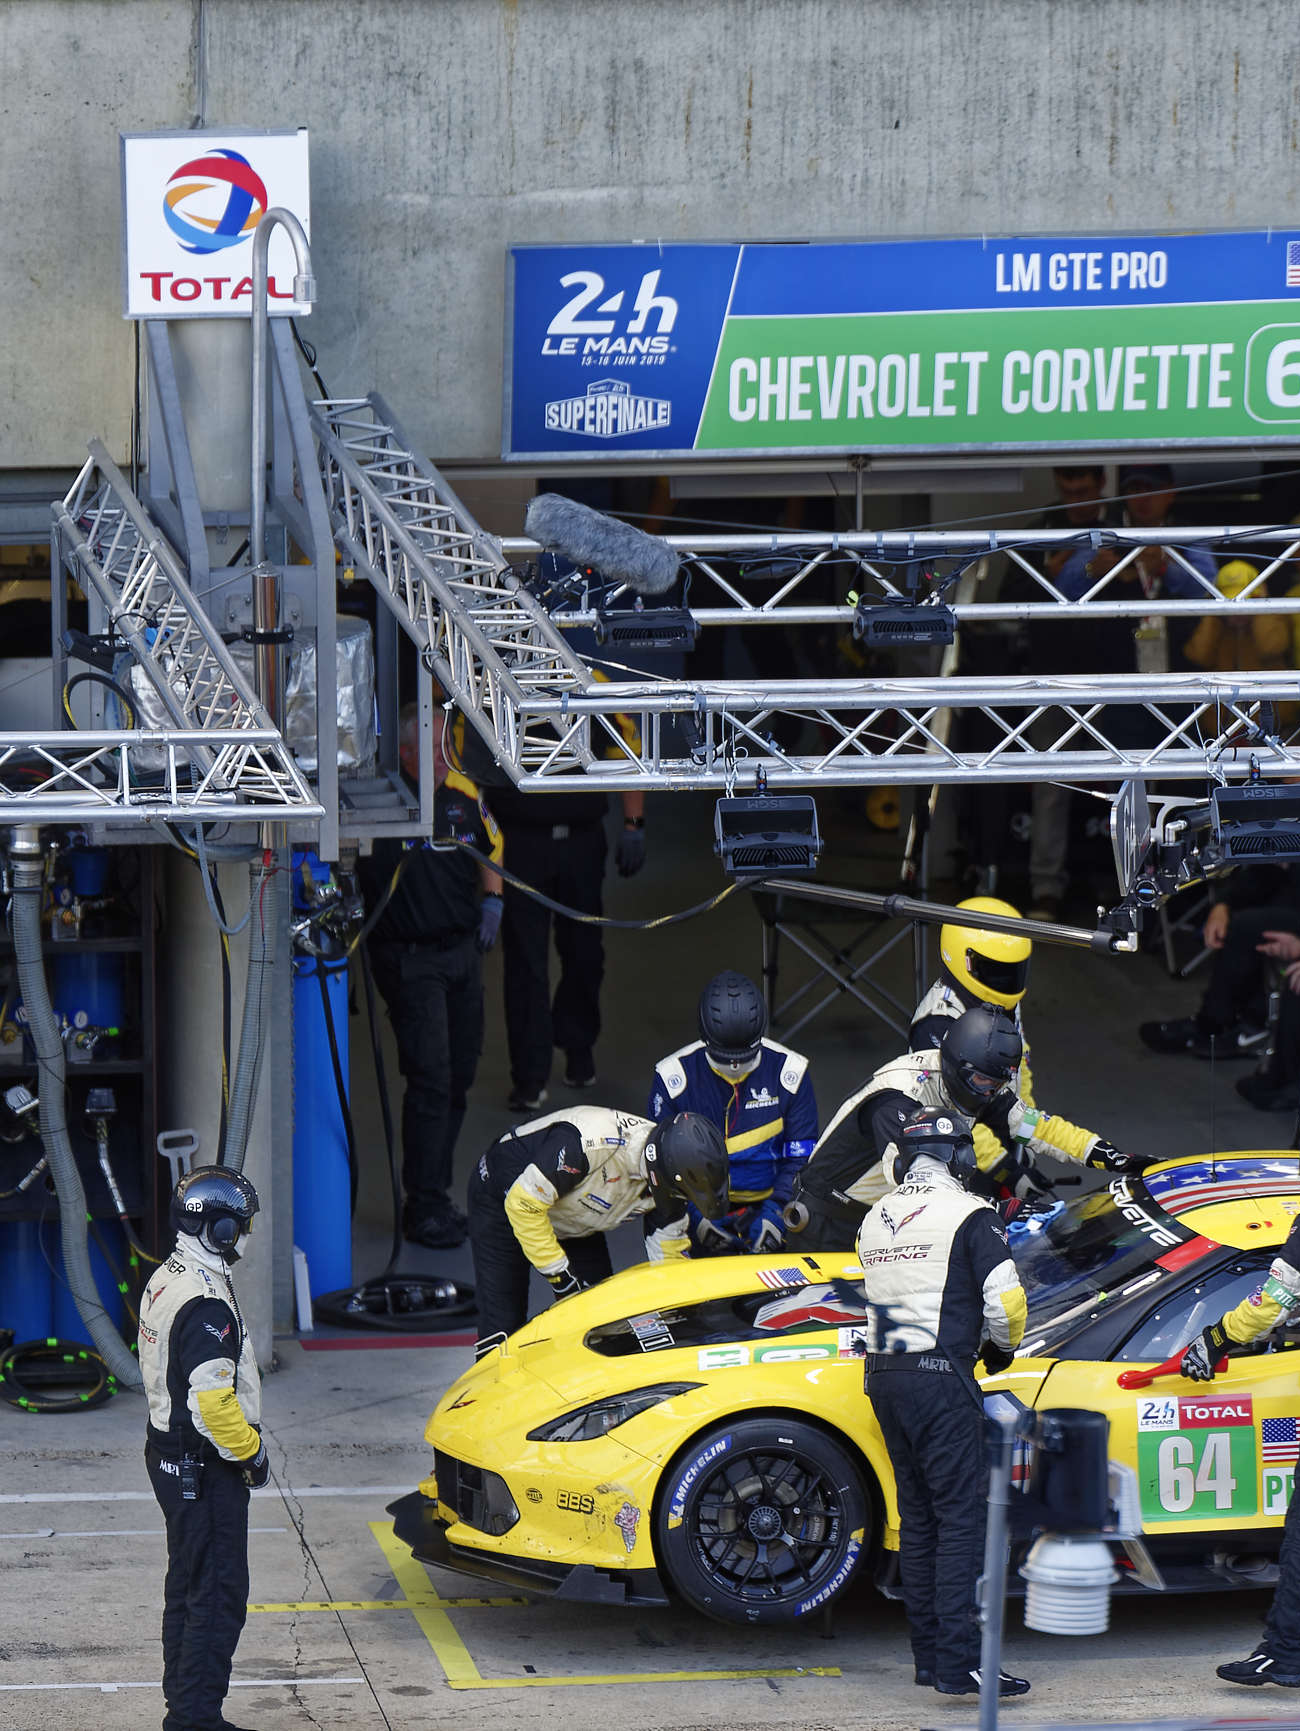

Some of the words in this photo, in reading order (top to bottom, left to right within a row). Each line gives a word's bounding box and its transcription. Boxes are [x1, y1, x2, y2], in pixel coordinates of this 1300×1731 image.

[139, 271, 295, 302] TOTAL
[996, 253, 1042, 292] LM
[1049, 252, 1103, 291] GTE
[1110, 251, 1168, 289] PRO
[546, 269, 679, 335] 24h
[541, 337, 579, 355] LE
[582, 336, 670, 355] MANS
[581, 355, 609, 366] 15-16
[612, 355, 637, 366] JUIN
[639, 354, 667, 366] 2019
[727, 350, 989, 422] CHEVROLET
[1001, 342, 1235, 415] CORVETTE
[546, 395, 670, 435] SUPERFINALE
[186, 1201, 202, 1213] GP
[1109, 1175, 1184, 1247] ORVETTE
[863, 1251, 928, 1266] RACING
[864, 1243, 933, 1258] CORVETTE
[1141, 1400, 1176, 1420] 24h
[1181, 1405, 1251, 1420] TOTAL
[675, 1440, 727, 1501] MICHELIN
[1157, 1431, 1238, 1513] 64
[556, 1489, 595, 1515] BBS
[801, 1554, 856, 1614] MICHELIN
